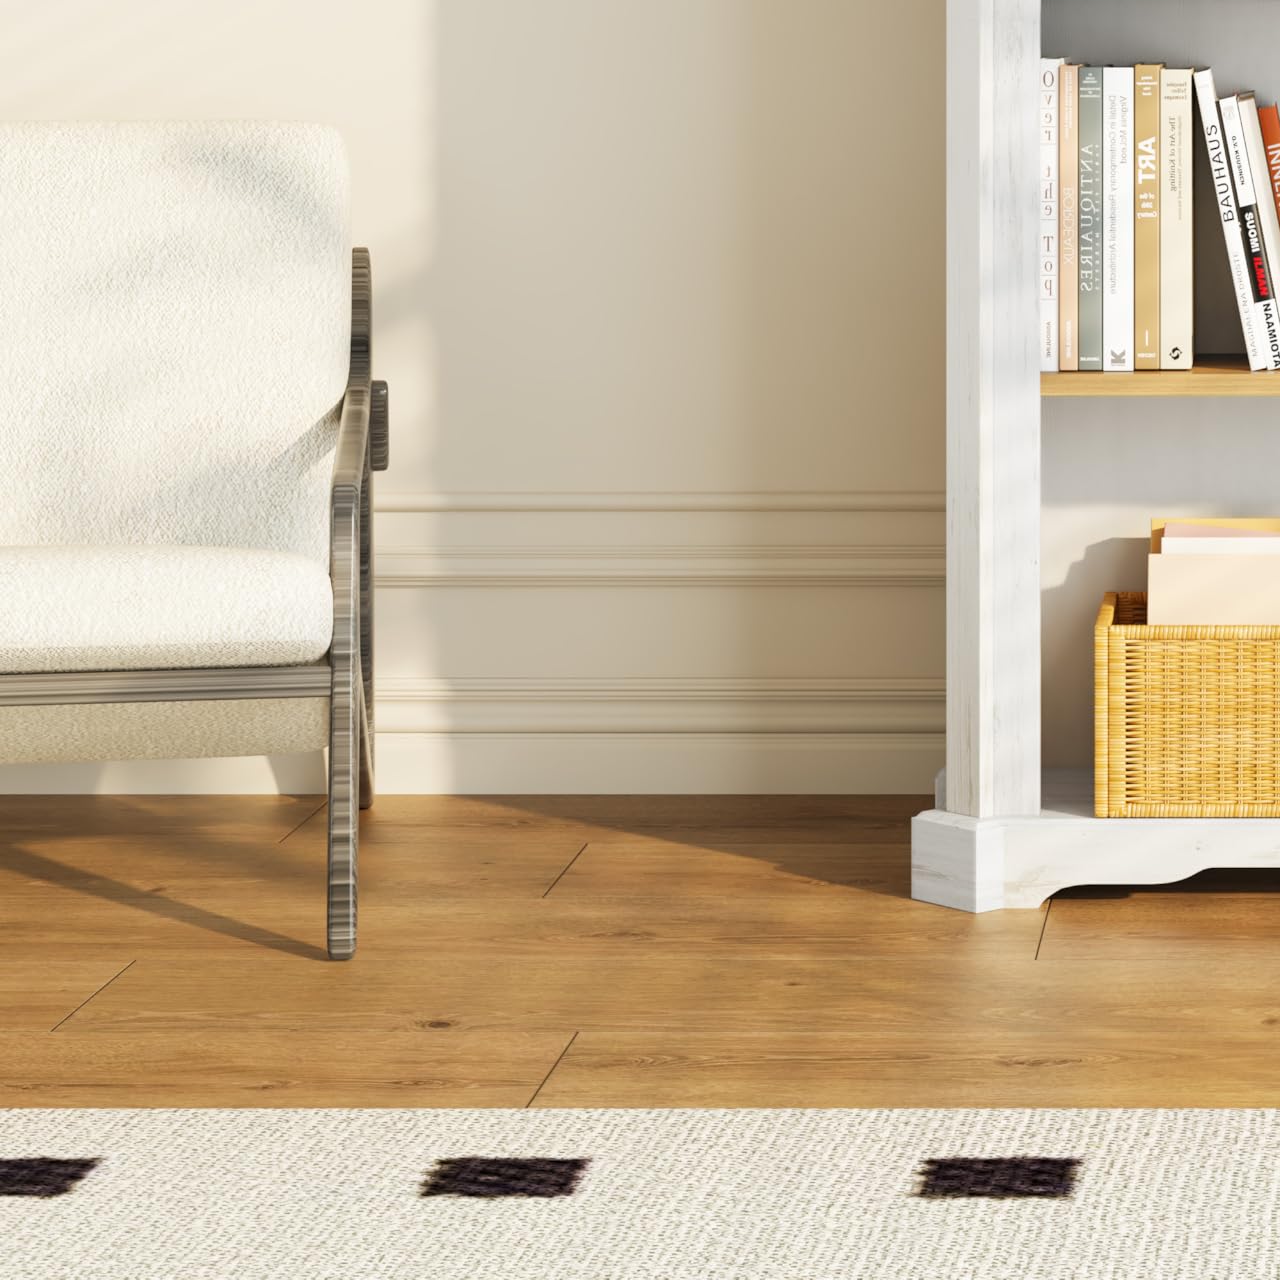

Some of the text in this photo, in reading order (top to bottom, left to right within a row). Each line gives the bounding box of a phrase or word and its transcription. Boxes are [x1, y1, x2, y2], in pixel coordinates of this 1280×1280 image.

[1206, 124, 1234, 222] BAUHAUS
[1244, 211, 1260, 253] SUOMI
[1252, 256, 1268, 297] ILMAN
